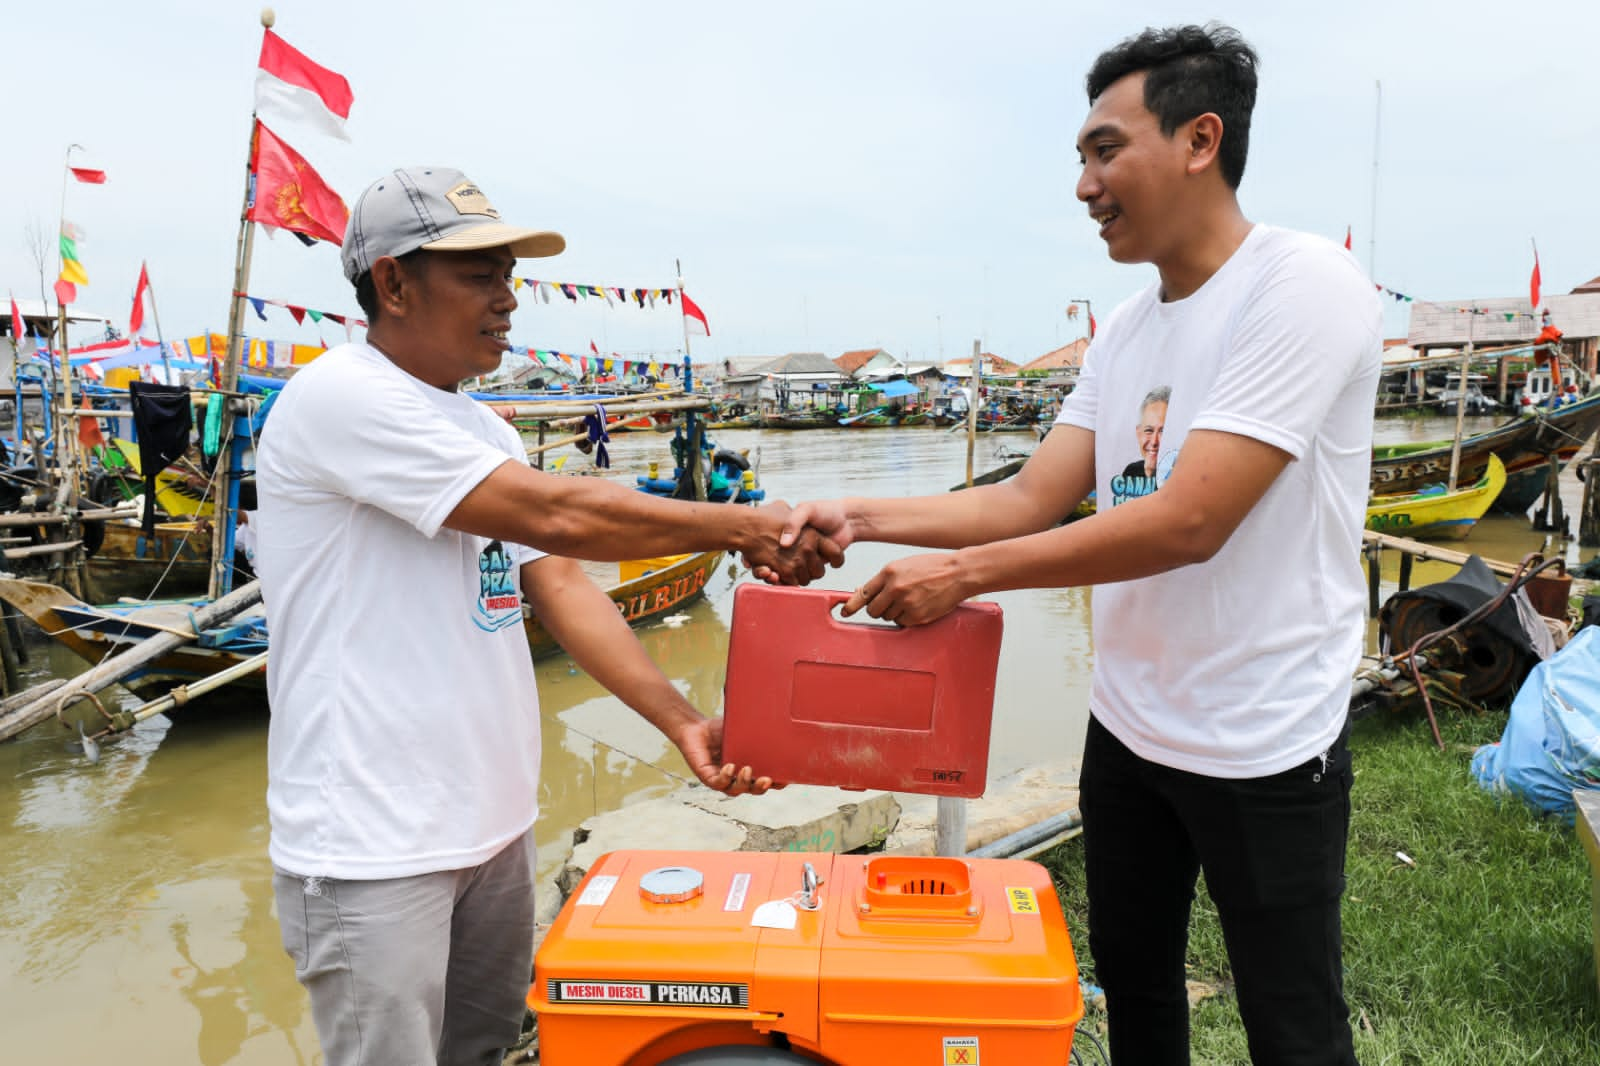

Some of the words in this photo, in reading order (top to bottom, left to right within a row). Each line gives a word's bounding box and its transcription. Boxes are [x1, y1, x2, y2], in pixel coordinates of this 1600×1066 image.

[567, 986, 604, 998] MESIN
[608, 986, 645, 999] DIESEL
[658, 985, 732, 1004] PERKASA
